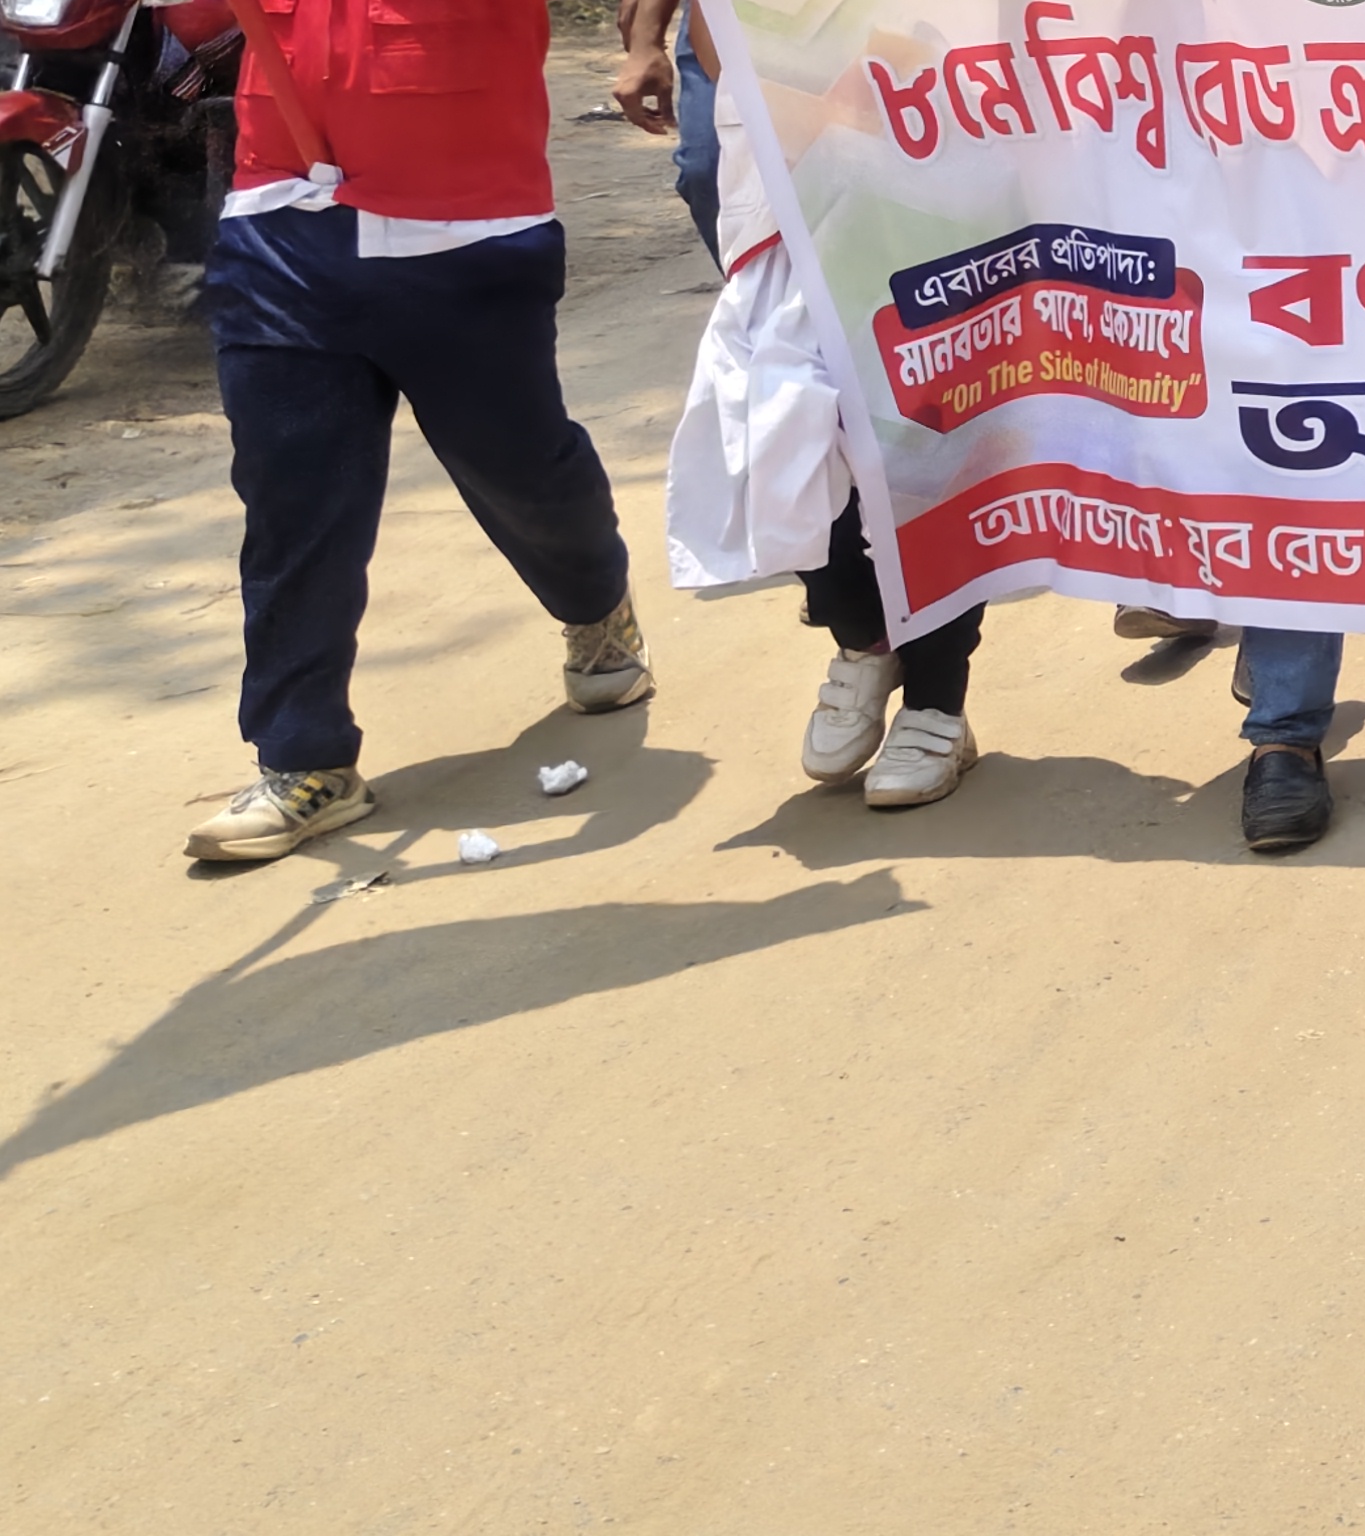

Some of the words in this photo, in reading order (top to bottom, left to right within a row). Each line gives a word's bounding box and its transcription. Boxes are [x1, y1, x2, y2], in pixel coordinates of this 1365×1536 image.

[1024, 1, 1168, 170] বিশ্ব
[1174, 40, 1295, 155] রেড
[914, 237, 1041, 307] এবারের
[893, 295, 1023, 387] মানবতার
[1032, 289, 1095, 344] পাশে,
[1099, 300, 1196, 359] একসাথে
[987, 359, 1033, 397] The
[1039, 350, 1083, 390] Side
[1085, 358, 1099, 388] of
[1178, 517, 1253, 589] যুব
[1268, 526, 1363, 578] রেড
